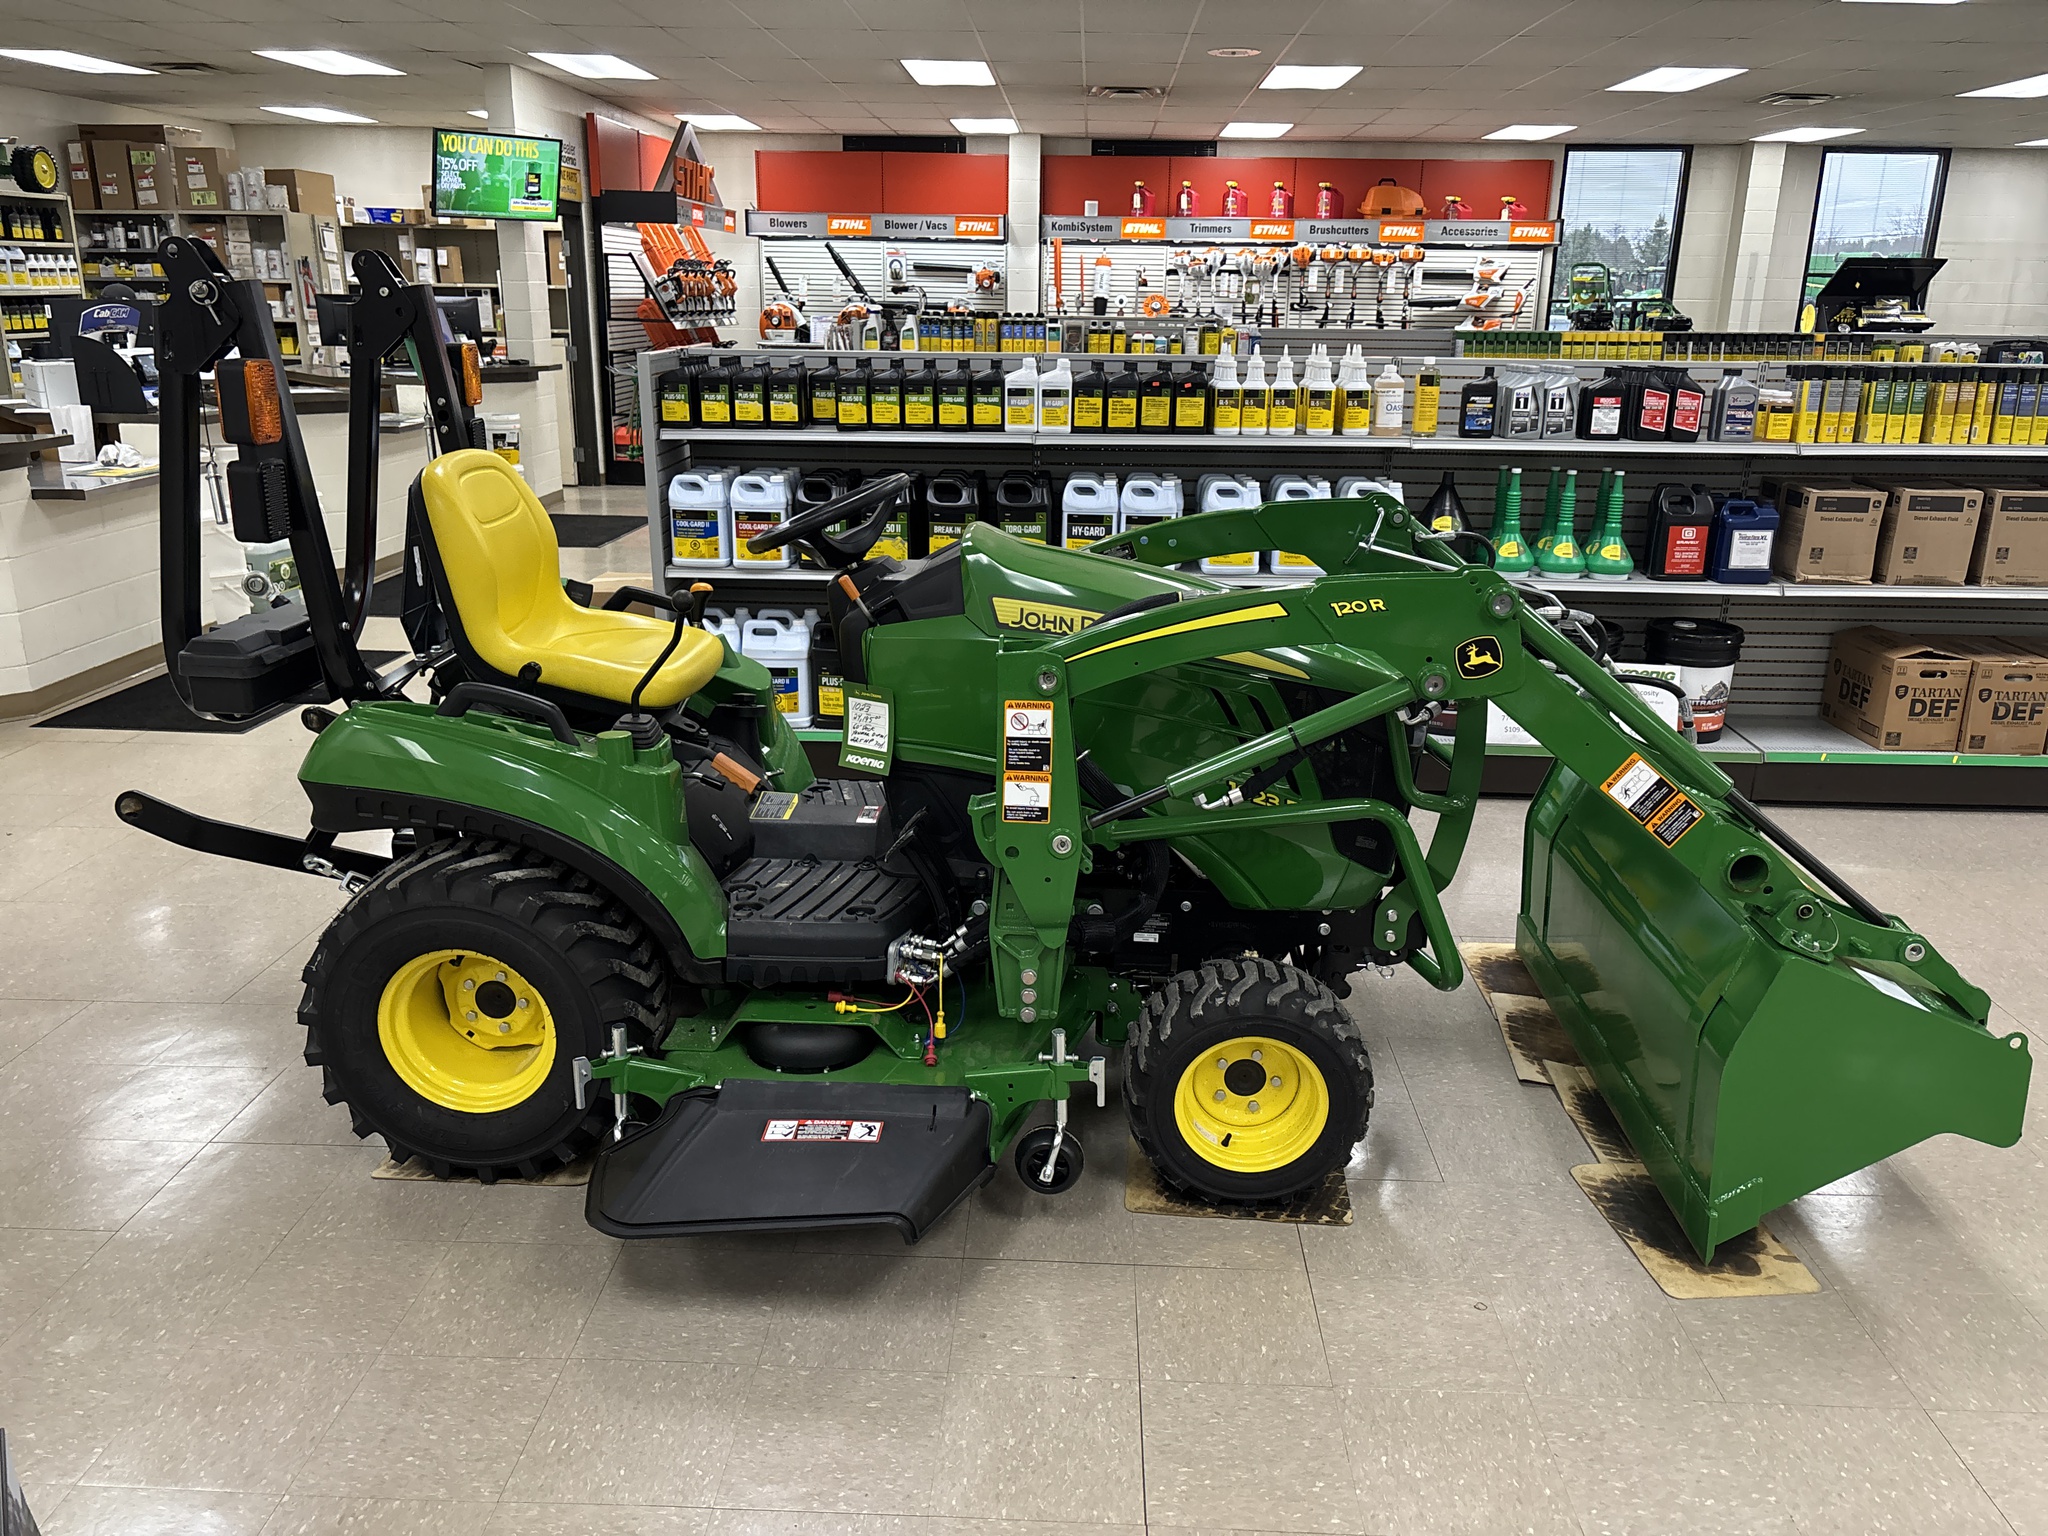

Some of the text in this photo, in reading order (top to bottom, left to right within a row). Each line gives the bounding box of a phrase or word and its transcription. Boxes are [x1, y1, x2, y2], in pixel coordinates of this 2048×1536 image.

[441, 134, 539, 158] YOU CAN DO THIS
[562, 142, 575, 156] ealer
[441, 158, 478, 171] 15% OFF
[674, 156, 714, 204] STIHL
[769, 218, 808, 228] Blowers
[830, 219, 867, 230] STIHL
[884, 220, 918, 230] Blower
[925, 221, 947, 230] Vacs
[957, 222, 994, 232] STIHL
[1051, 222, 1113, 233] KombiSystem
[1124, 223, 1161, 233] STIHL
[1190, 223, 1232, 234] Trimmers
[1252, 224, 1290, 235] STIHL
[1310, 225, 1369, 236] Brushcutters
[1382, 226, 1419, 237] STIHL
[1441, 226, 1498, 236] Accessories
[1512, 227, 1550, 237] STIHL
[94, 308, 130, 318] CabCAM
[1519, 398, 1525, 409] 1
[1554, 398, 1560, 409] 1
[896, 524, 901, 532] II
[1005, 525, 1041, 534] TORQ-GARD
[1072, 526, 1105, 536] HY-GARD
[1011, 608, 1074, 632] JOHN
[1843, 664, 1874, 688] TARTAN
[1839, 677, 1871, 709] DEF
[1911, 687, 1963, 698] TARTAN
[1995, 691, 2048, 701] TARTAN
[852, 702, 871, 712] 1023
[1908, 699, 1960, 717] DEF
[1992, 702, 2045, 721] DEF
[1612, 758, 1636, 781] WARNING
[1229, 781, 1280, 806] 123
[1657, 798, 1682, 821] WARNING
